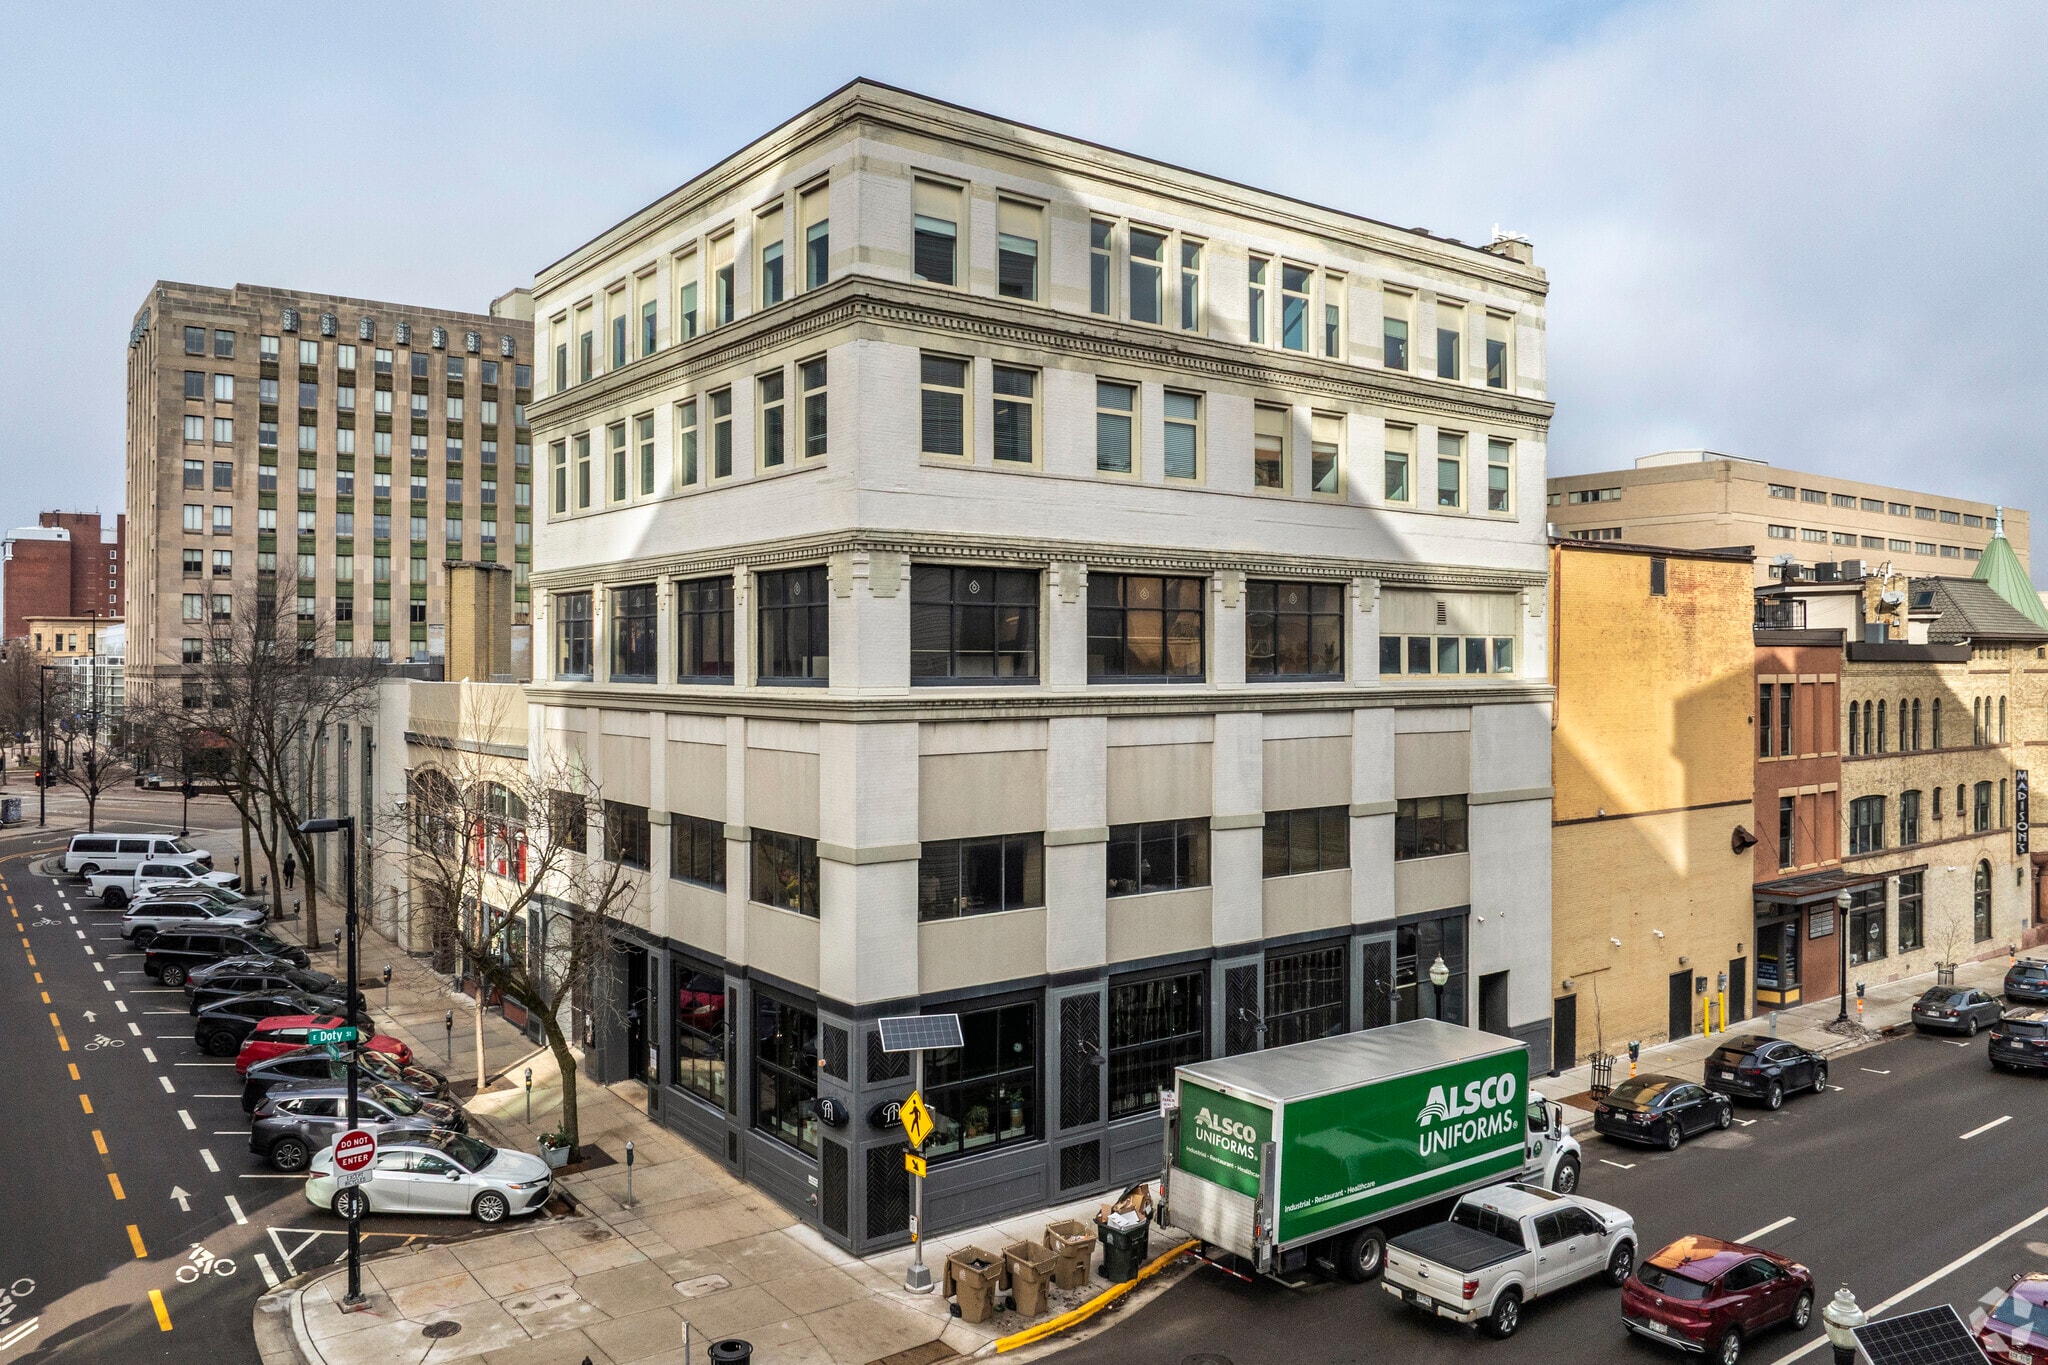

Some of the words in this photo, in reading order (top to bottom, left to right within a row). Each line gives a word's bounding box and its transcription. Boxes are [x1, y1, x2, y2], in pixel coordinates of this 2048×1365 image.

[2016, 771, 2028, 853] MADISON'S
[320, 1031, 343, 1042] Doty
[1415, 1073, 1516, 1127] ALSCO
[1194, 1107, 1257, 1143] ALSCO
[341, 1140, 352, 1149] DO
[353, 1136, 369, 1146] NOT
[342, 1154, 369, 1166] ENTER
[1185, 1145, 1207, 1158] Industrial
[1210, 1154, 1235, 1169] Restaurant
[1237, 1164, 1260, 1178] Healthcar
[1284, 1198, 1311, 1213] Industrial
[1314, 1189, 1344, 1204] Restaurant
[1347, 1181, 1376, 1194] Healthcare
